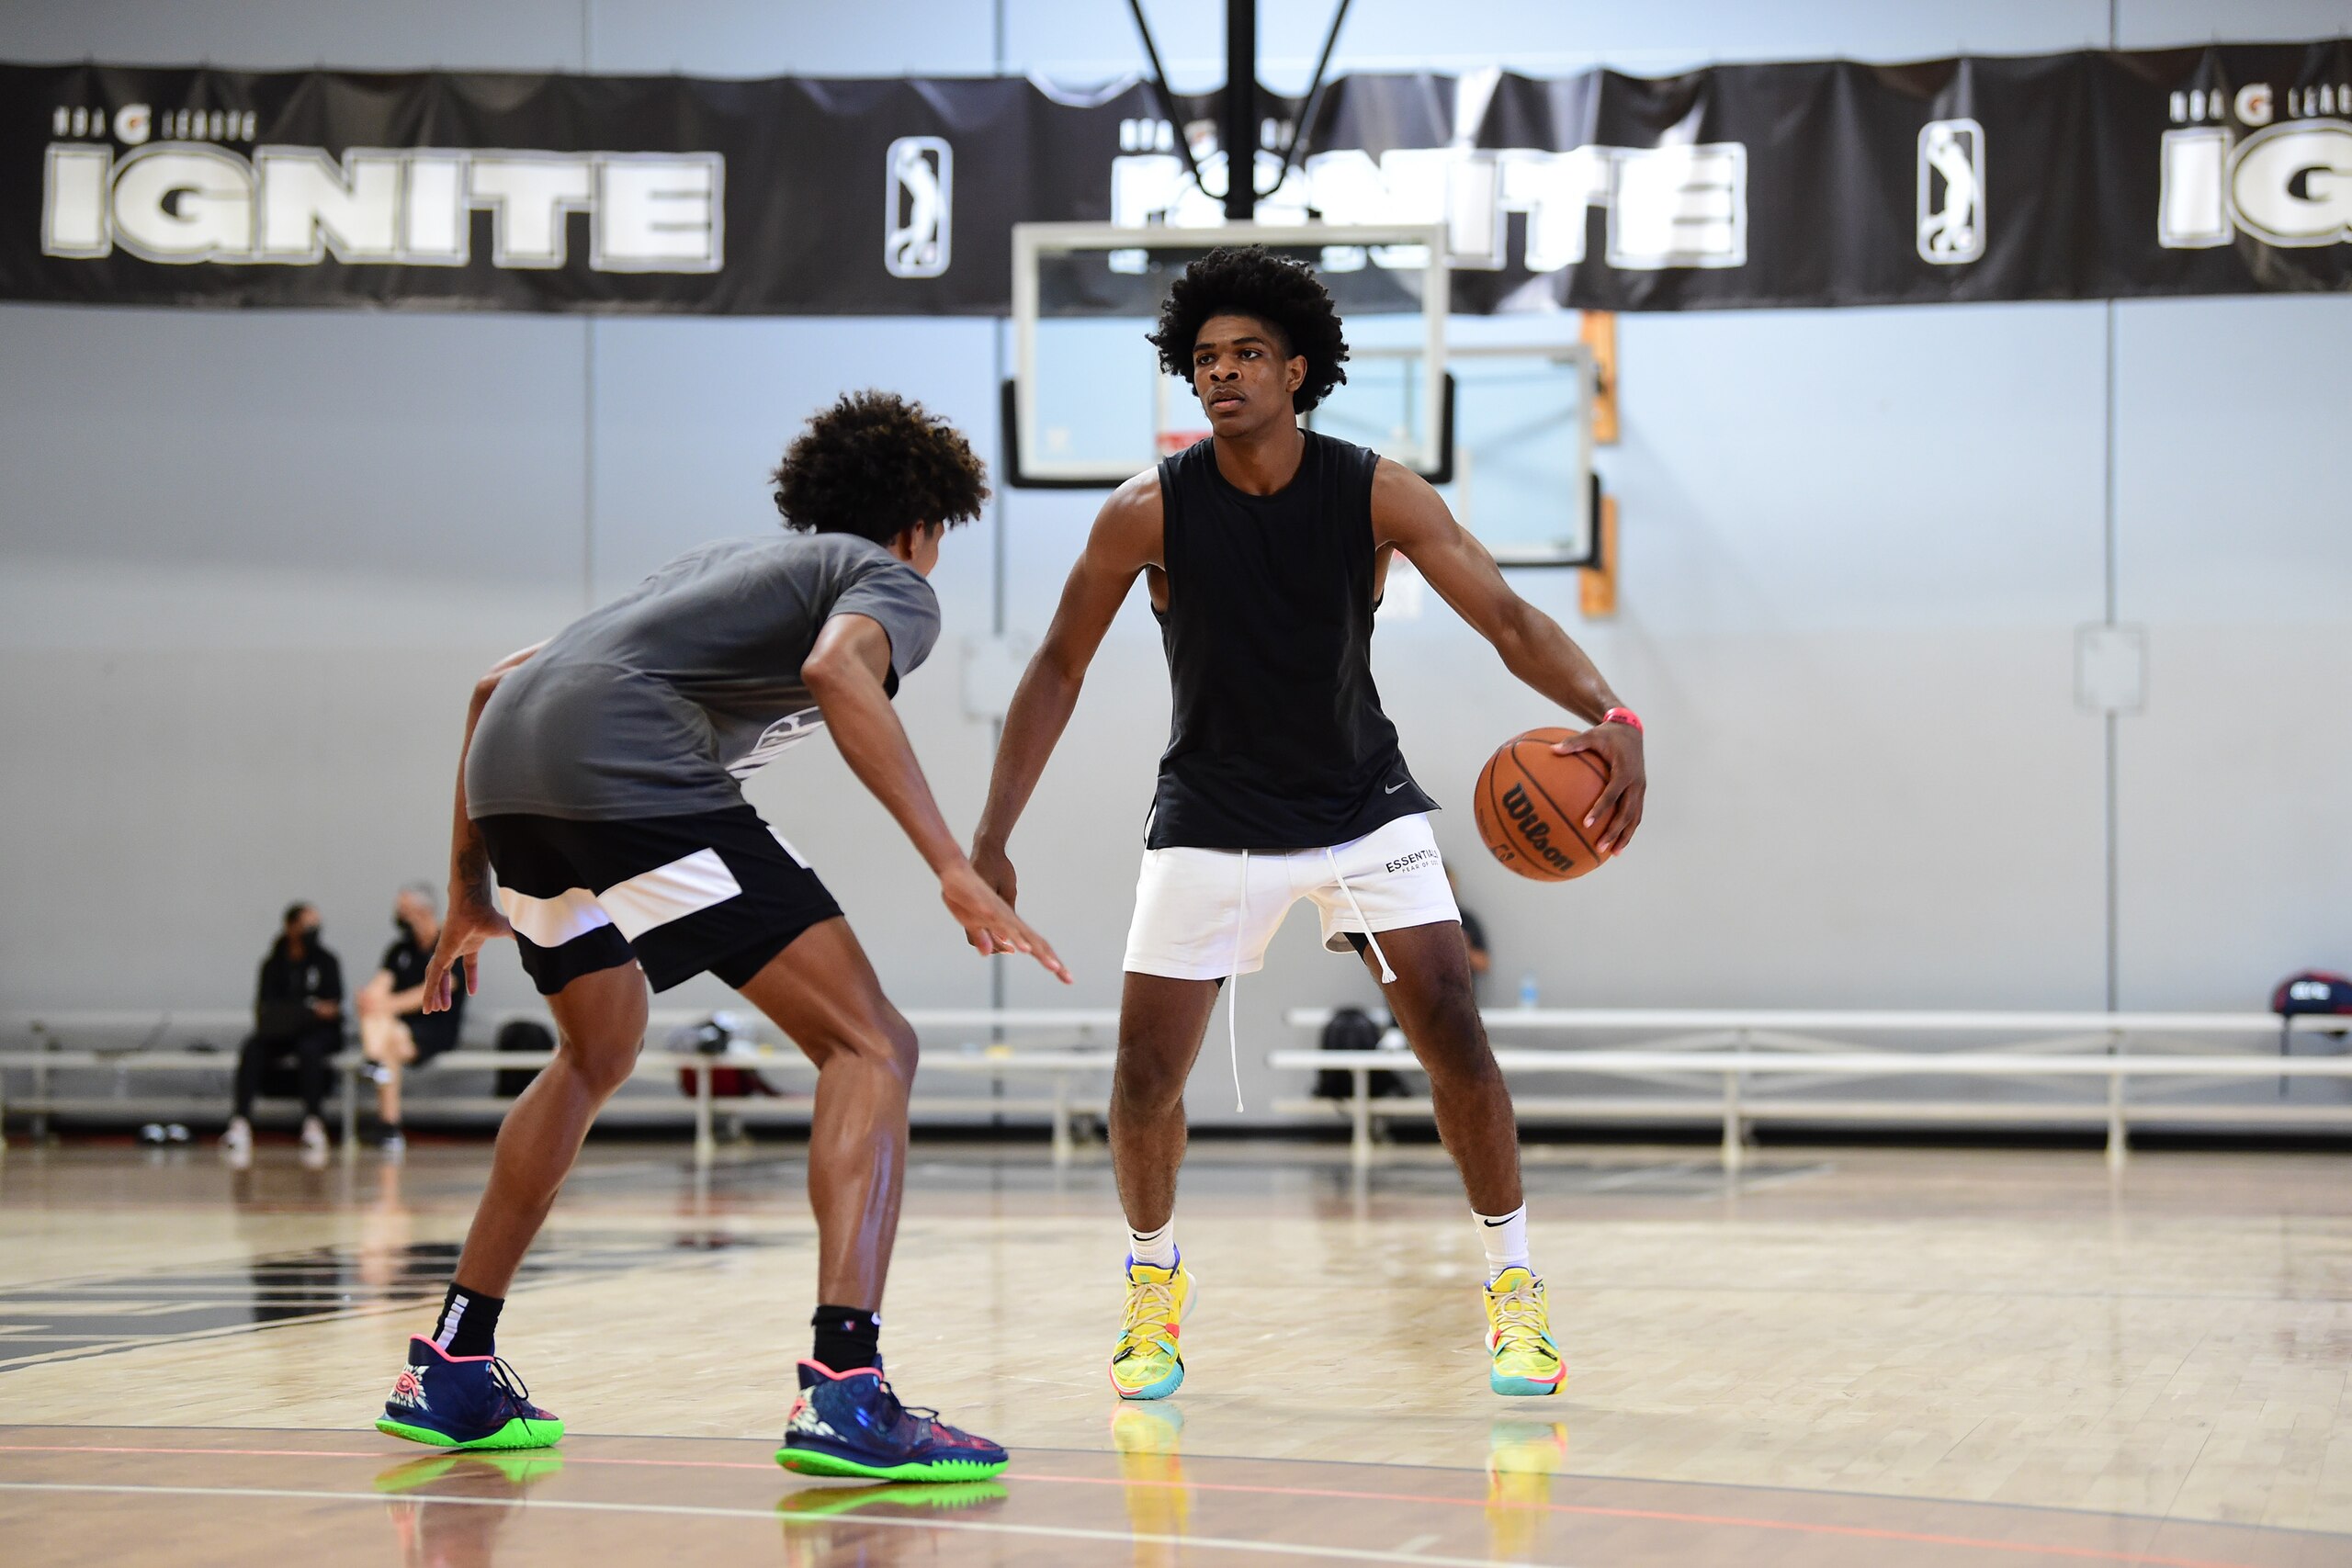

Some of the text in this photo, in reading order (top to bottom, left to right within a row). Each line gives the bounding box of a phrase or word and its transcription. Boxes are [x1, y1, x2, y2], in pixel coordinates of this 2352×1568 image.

[41, 141, 726, 273] IGNITE
[1402, 863, 1419, 874] FEAR
[1502, 782, 1576, 872] Wilson
